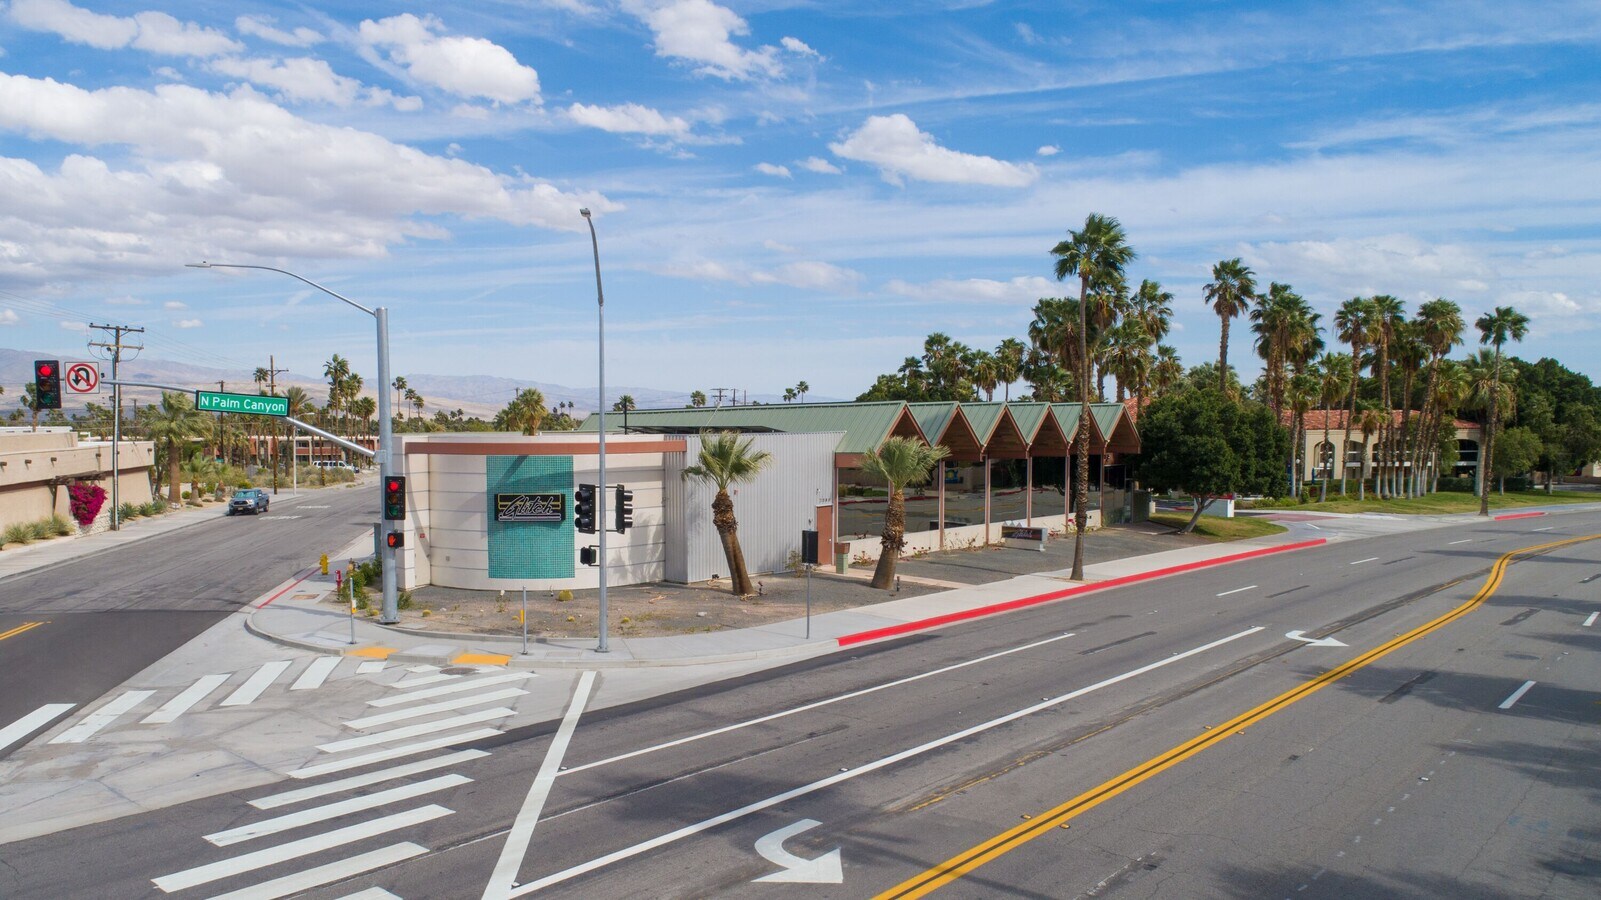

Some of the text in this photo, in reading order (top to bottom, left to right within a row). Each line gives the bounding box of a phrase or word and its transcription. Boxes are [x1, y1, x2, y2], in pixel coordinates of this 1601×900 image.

[201, 396, 285, 413] N Palm Canyon
[502, 494, 554, 521] Glitch
